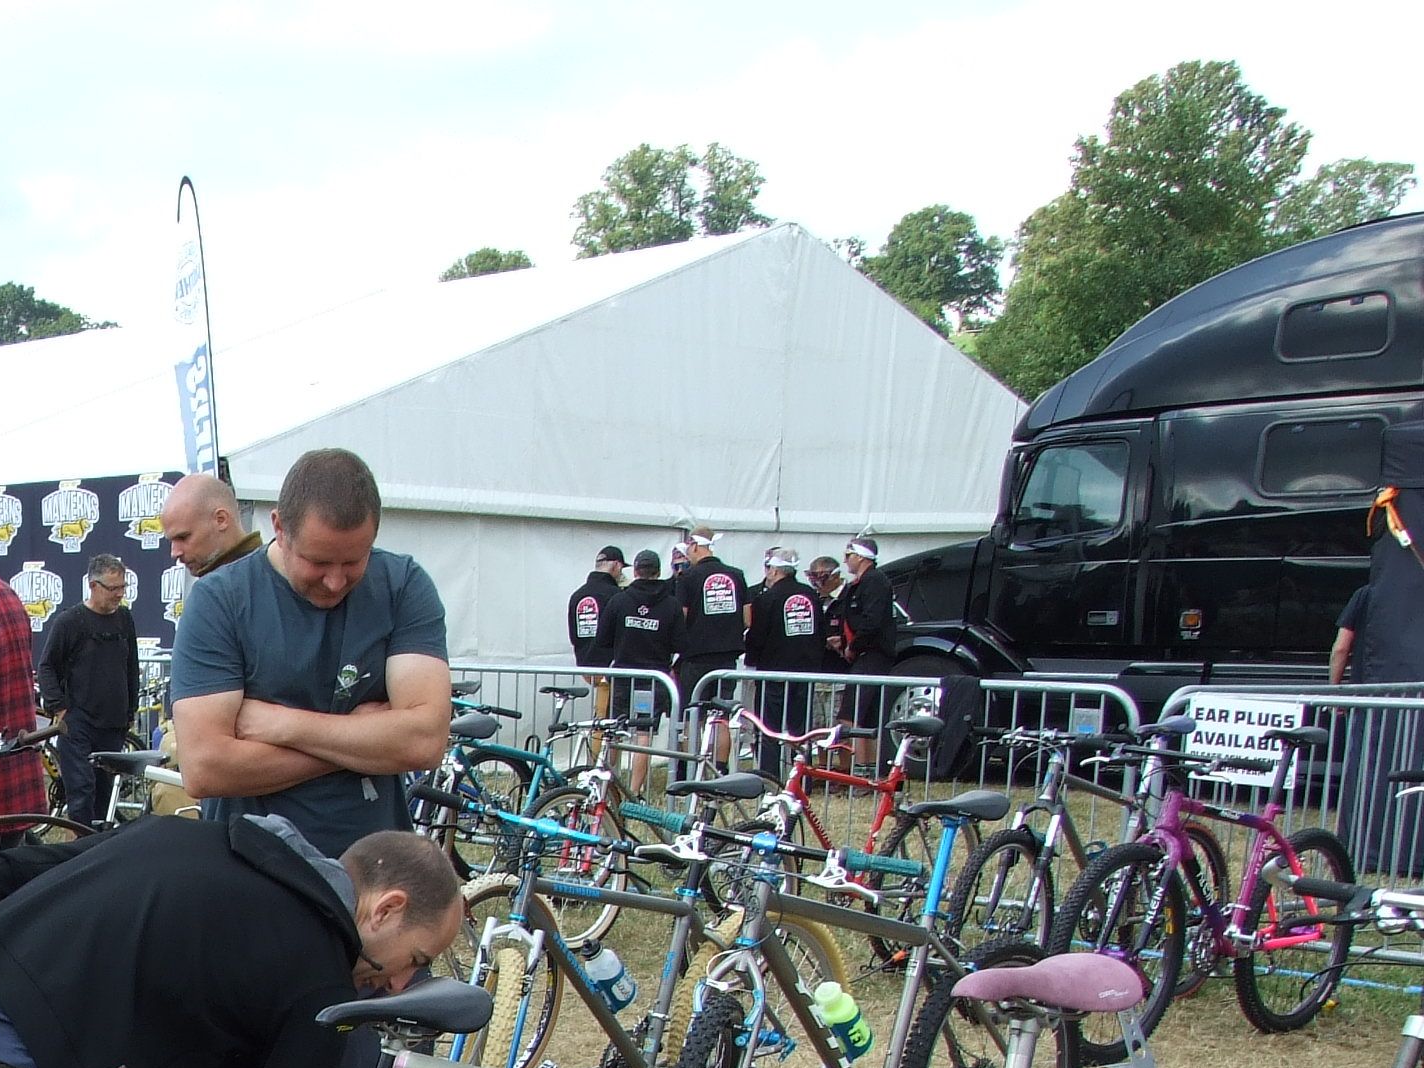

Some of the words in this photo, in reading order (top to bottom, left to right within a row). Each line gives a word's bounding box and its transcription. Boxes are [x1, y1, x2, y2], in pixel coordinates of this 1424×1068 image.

[42, 490, 99, 525] MALVERNS
[1195, 707, 1229, 723] EAR
[1233, 710, 1295, 728] PLUGS
[1192, 731, 1282, 752] AVAILABL
